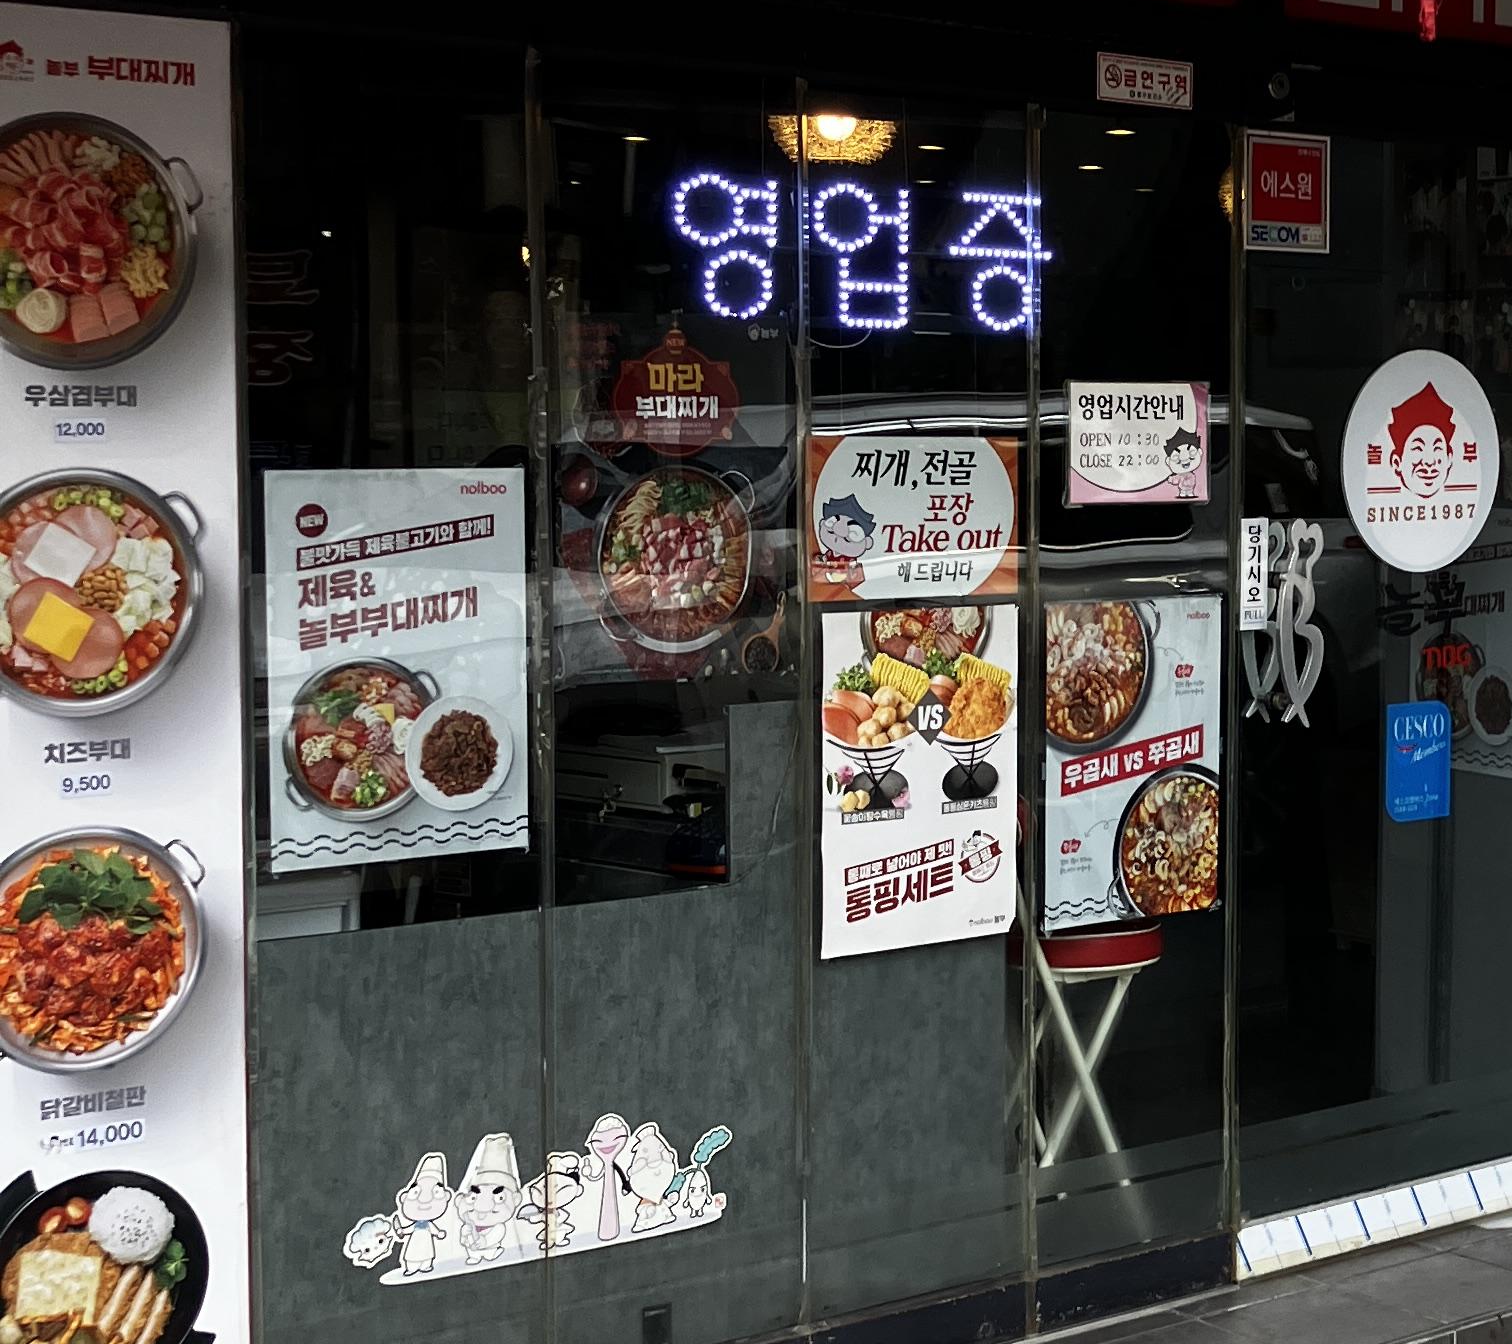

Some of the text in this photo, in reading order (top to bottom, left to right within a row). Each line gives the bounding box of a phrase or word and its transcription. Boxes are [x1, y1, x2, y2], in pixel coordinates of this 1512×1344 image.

[87, 55, 196, 86] 부대찌개
[1124, 68, 1188, 96] 금연구역
[1260, 170, 1313, 201] 에스원
[1251, 224, 1300, 244] SECOM
[672, 170, 1054, 333] 영업중
[647, 362, 705, 393] 마라
[24, 384, 138, 408] 우삼겹부대
[635, 395, 719, 419] 부대찌개
[1078, 394, 1184, 421] 영업시간안내
[56, 422, 105, 438] 12,000
[1079, 432, 1112, 447] OPEN
[1079, 453, 1113, 468] CLOSE
[1366, 442, 1477, 465] 놀 부
[460, 481, 507, 495] nolboo
[299, 513, 325, 529] NEW
[923, 492, 975, 526] 포장
[1366, 503, 1476, 523] SINCE1987
[881, 523, 1004, 554] Take out
[1246, 524, 1263, 603] 당기시오
[298, 569, 376, 609] 제육&
[298, 586, 478, 651] 놀부부대찌개
[917, 704, 944, 733] VS
[1394, 713, 1445, 741] CESCO
[62, 774, 112, 793] 9,500
[846, 861, 954, 923] 통핑세트
[40, 1085, 147, 1120] 닭갈비철판
[77, 1120, 143, 1147] 14,000
